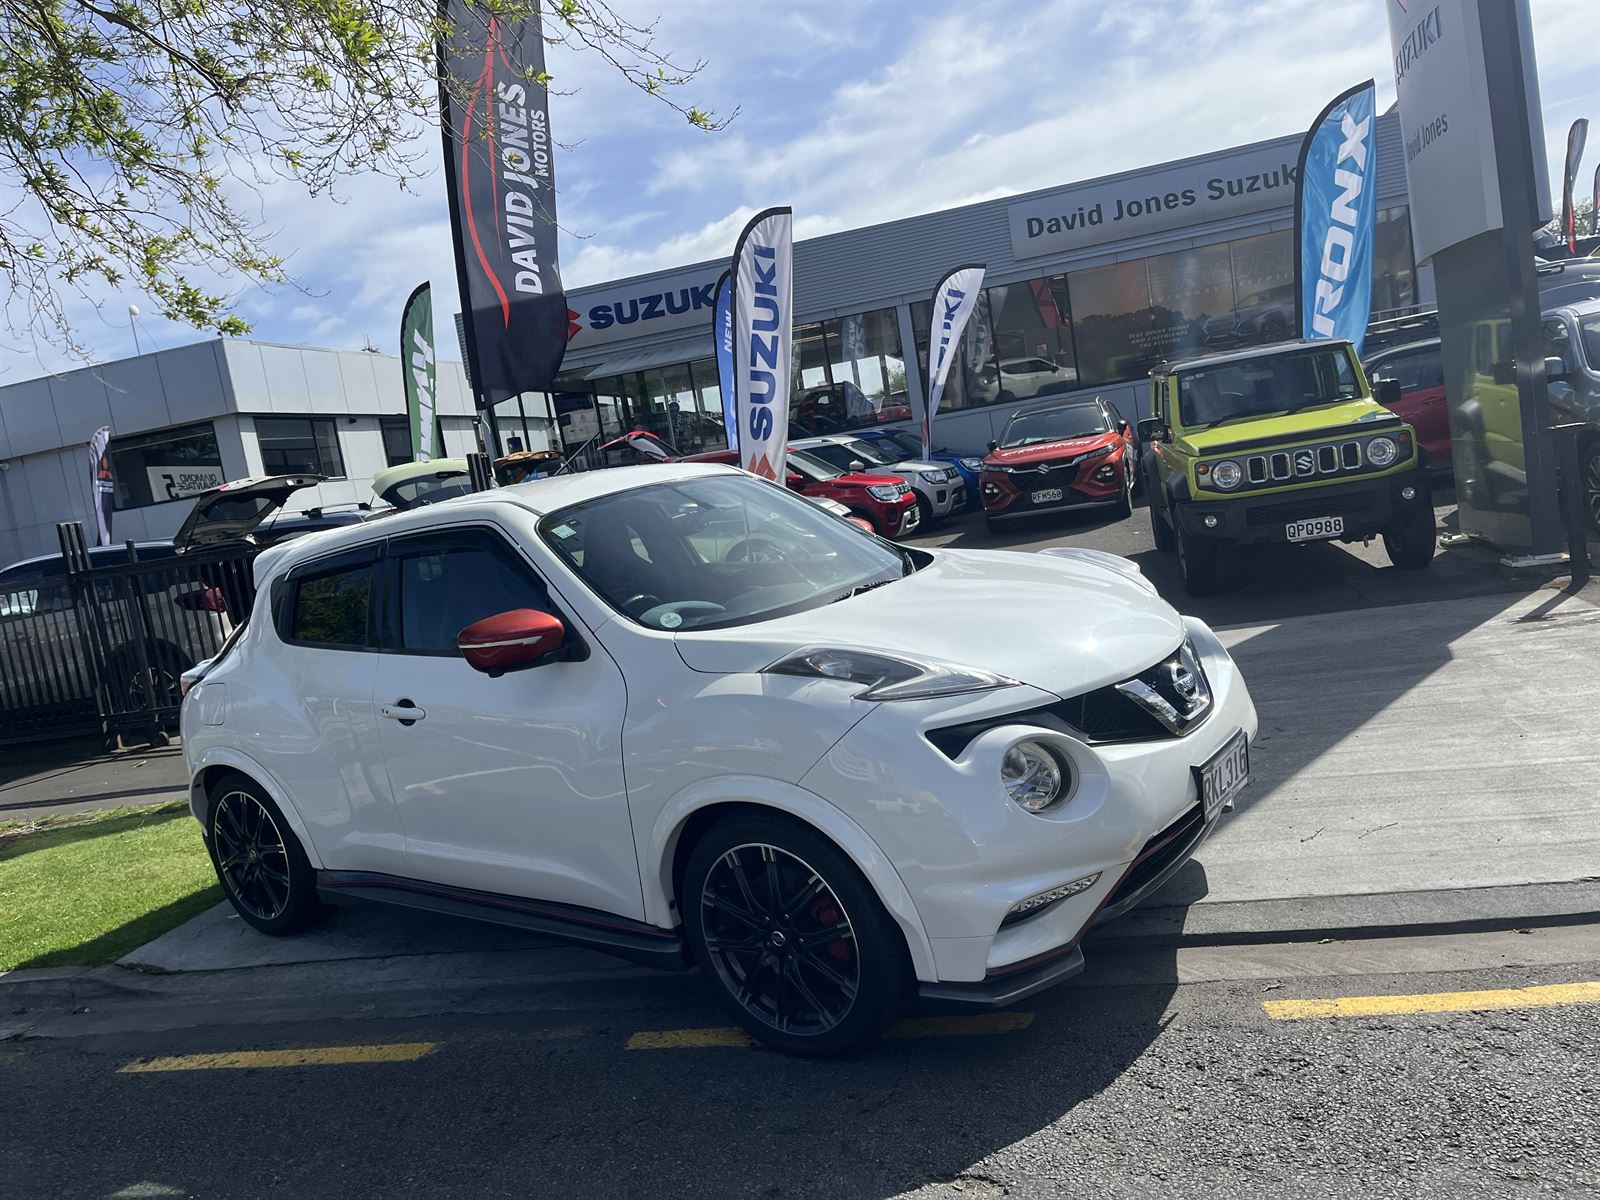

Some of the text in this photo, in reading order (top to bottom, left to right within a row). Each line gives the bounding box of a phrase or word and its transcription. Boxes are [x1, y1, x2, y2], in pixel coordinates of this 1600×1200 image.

[531, 109, 549, 176] MOTORS
[1422, 113, 1448, 150] Jones
[499, 81, 542, 294] DAVID JONES
[1026, 163, 1297, 238] David Jones Suzuk
[1311, 111, 1370, 340] RONX
[588, 283, 716, 330] SUZUK
[724, 311, 733, 353] NEW
[750, 245, 779, 441] SUZUKI
[1288, 519, 1342, 538] QPQ988
[1203, 747, 1246, 810] RKL316
